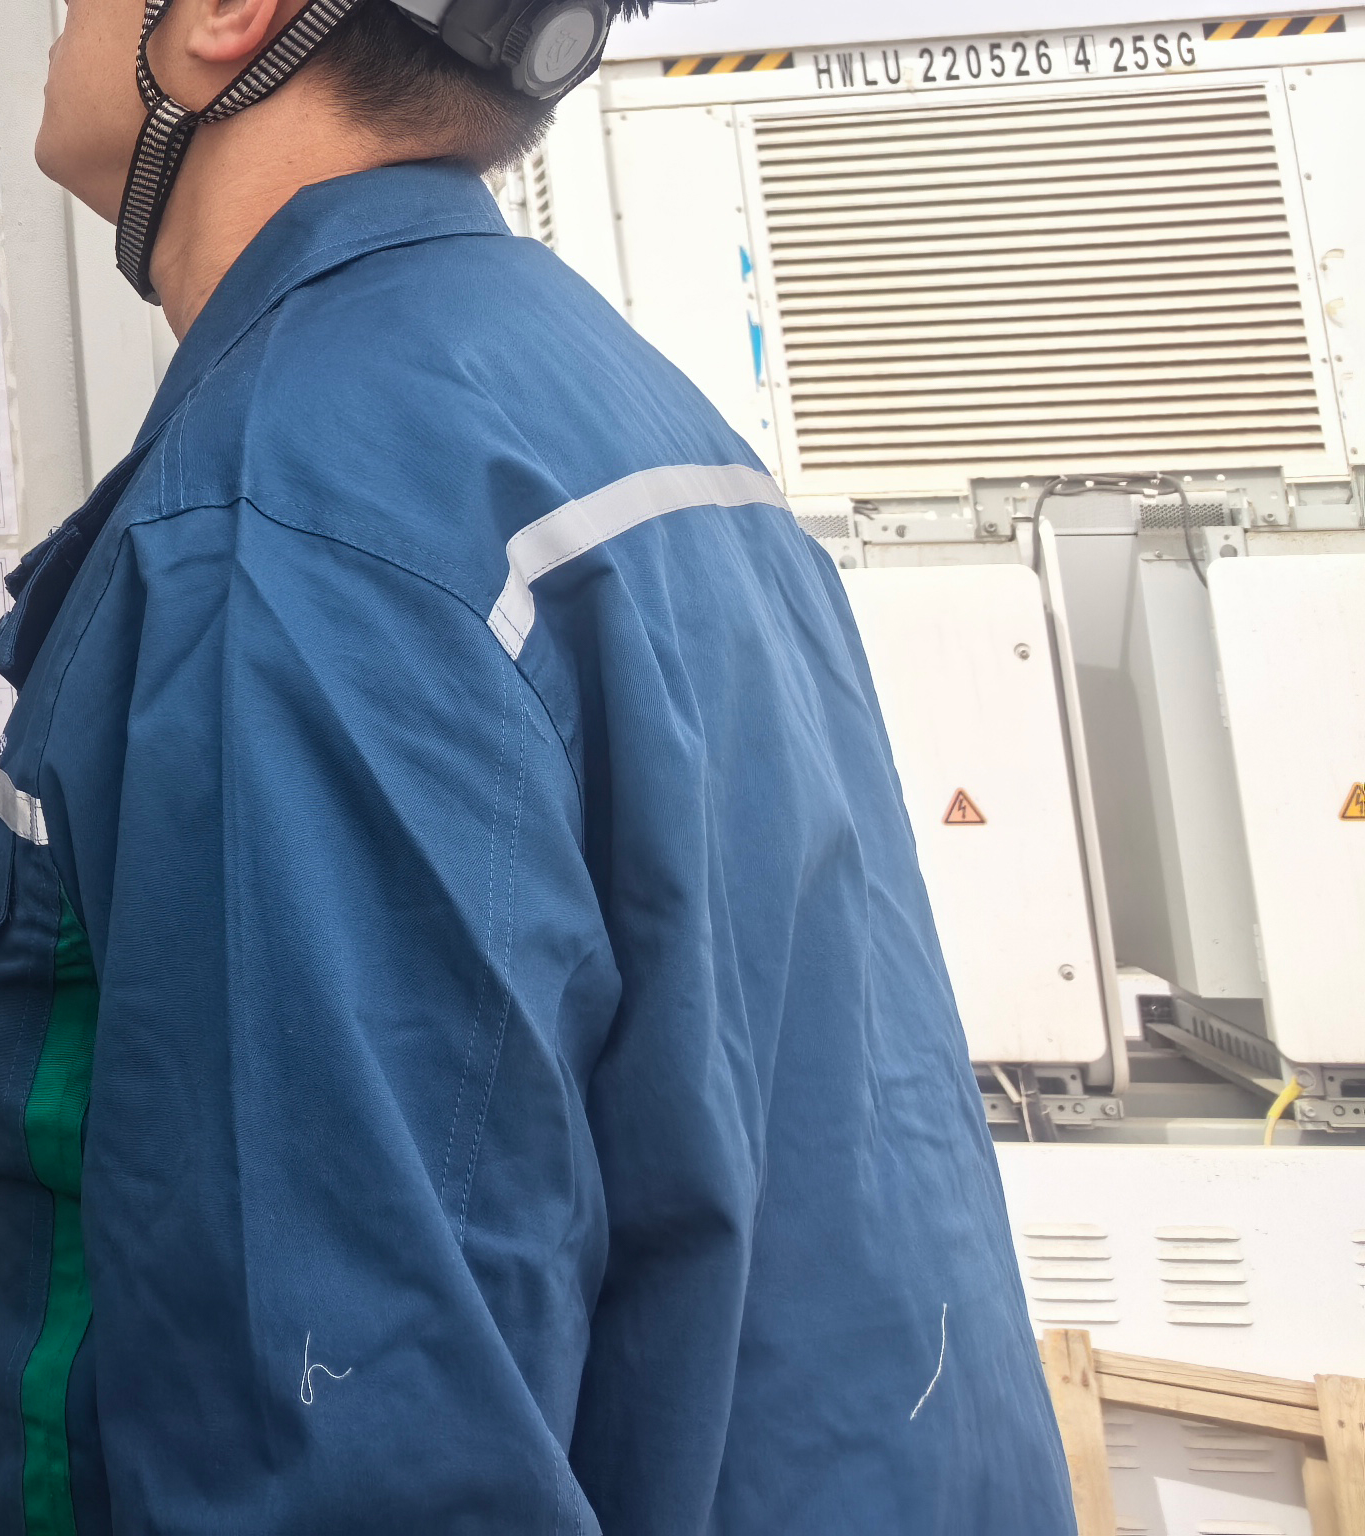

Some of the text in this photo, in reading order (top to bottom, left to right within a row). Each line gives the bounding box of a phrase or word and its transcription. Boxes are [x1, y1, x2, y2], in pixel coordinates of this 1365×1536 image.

[813, 31, 1198, 90] HWLU 220526 4 25SG
